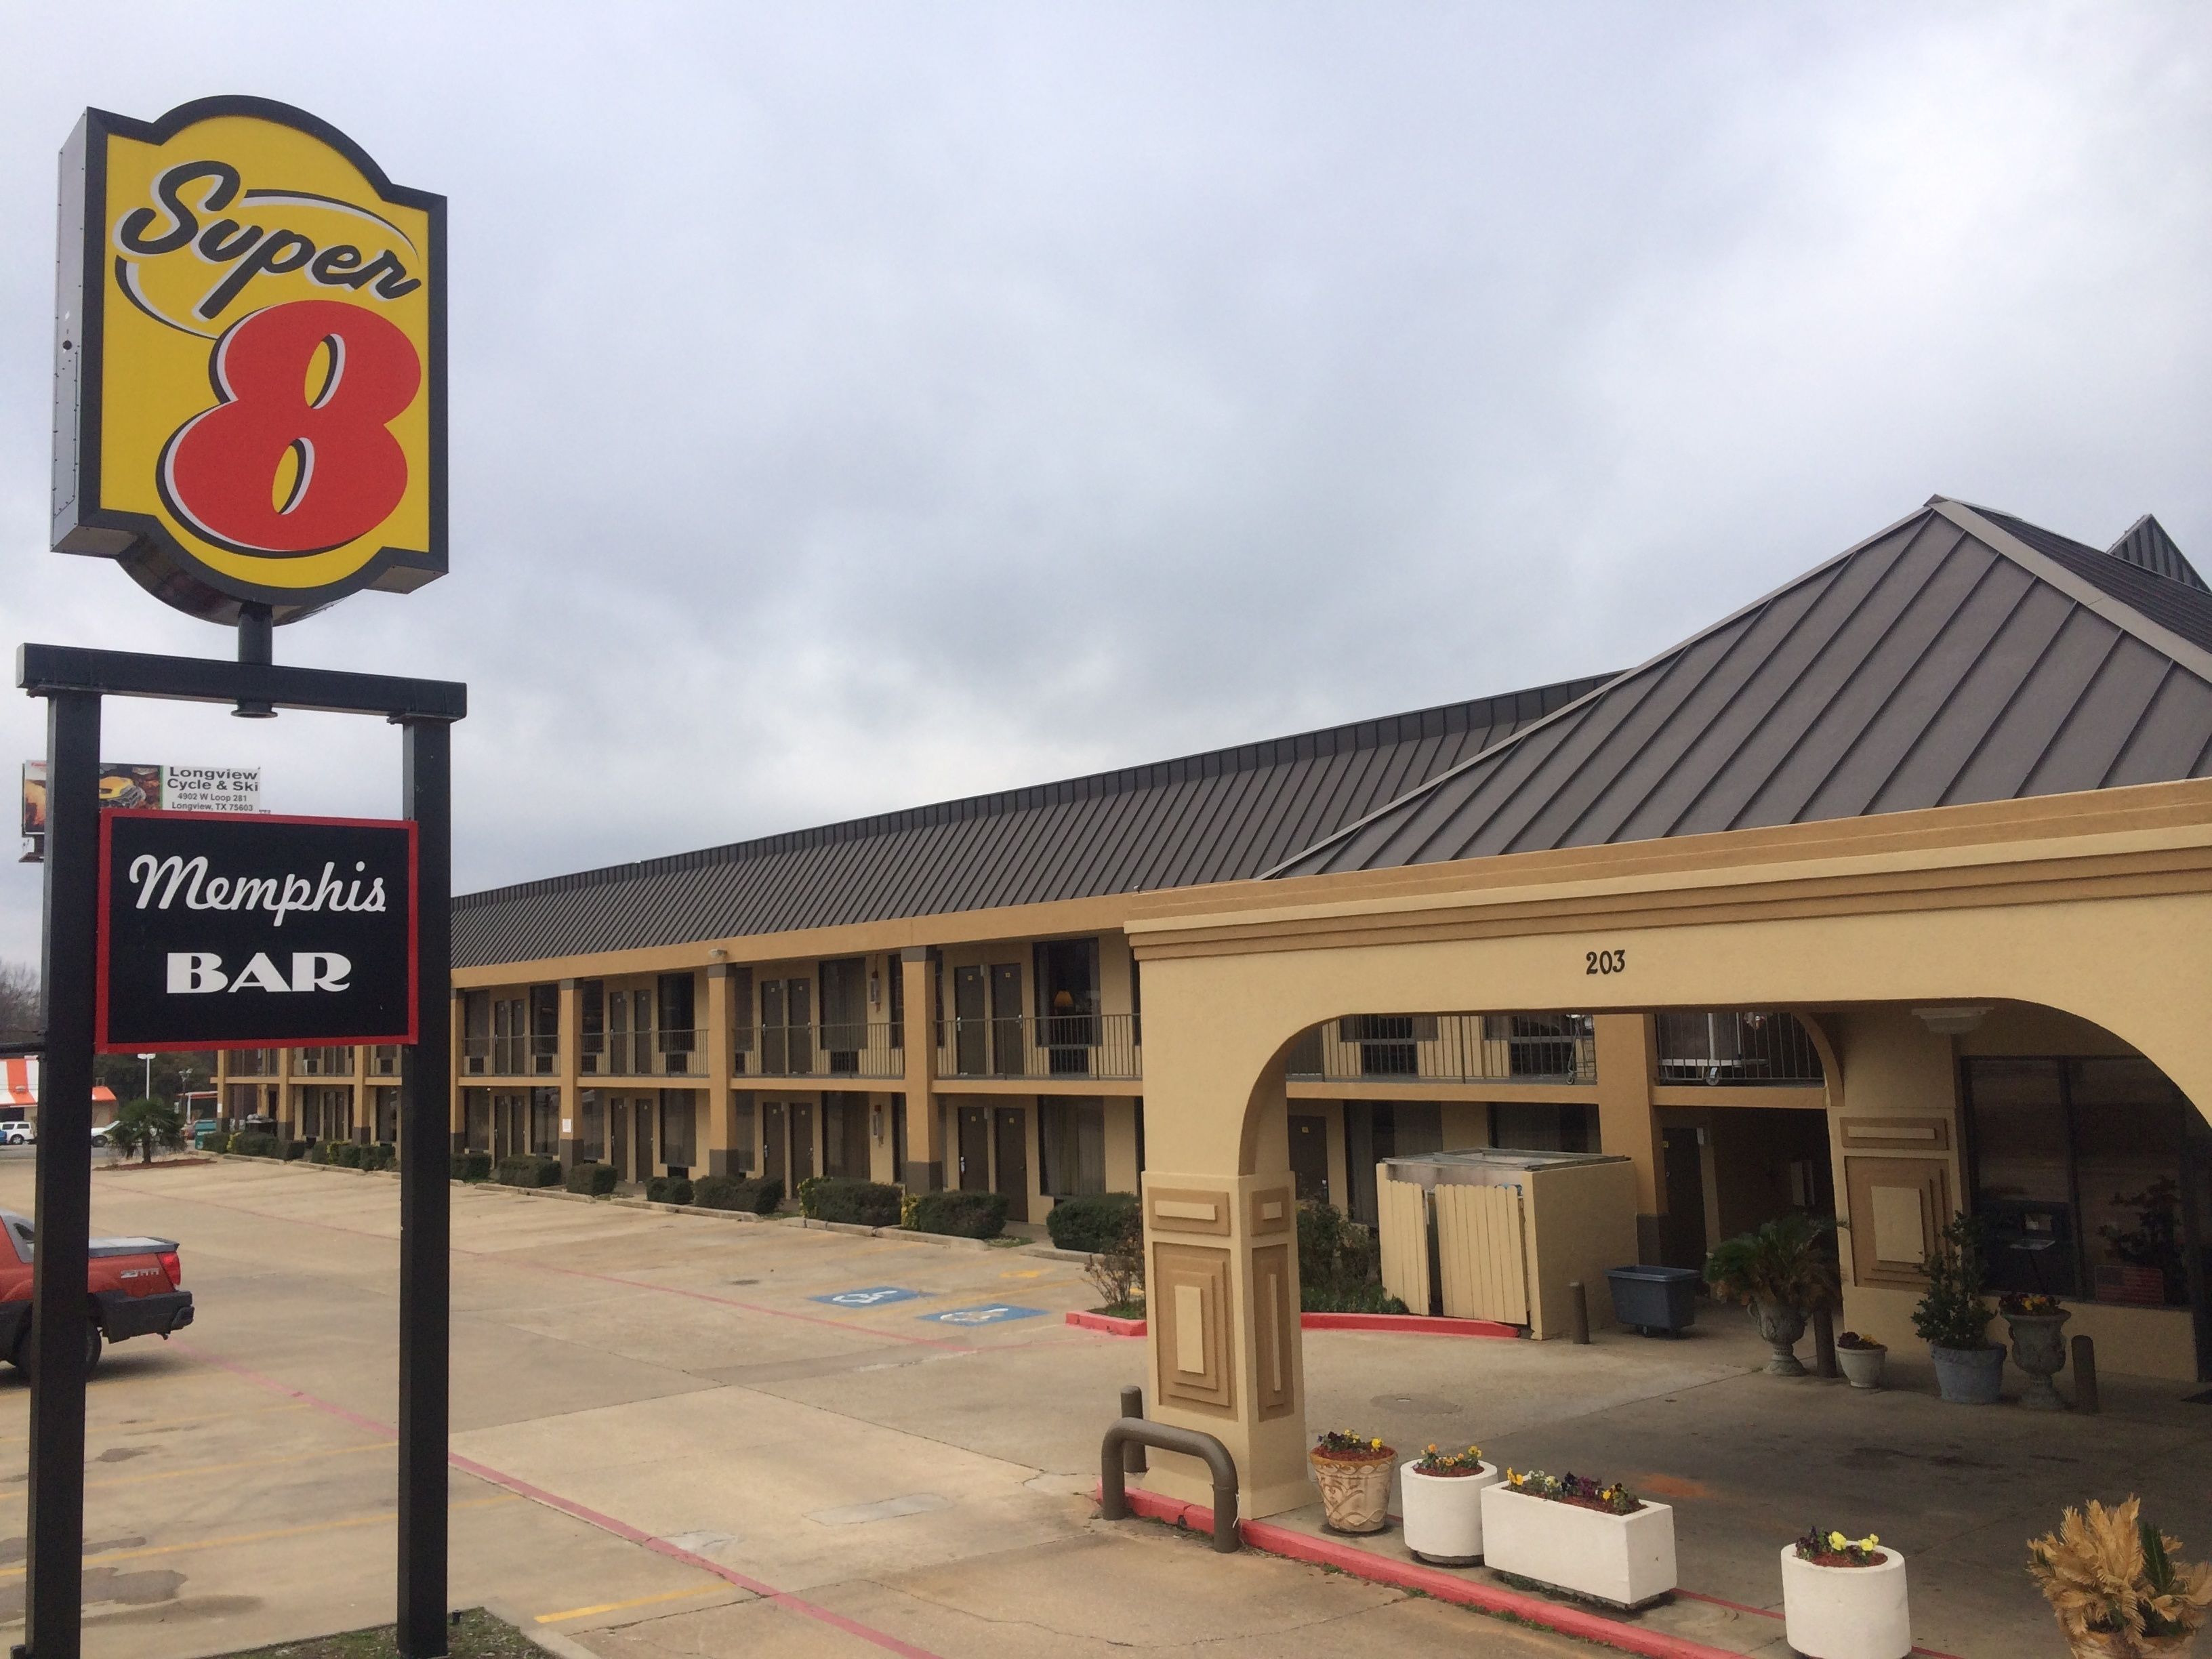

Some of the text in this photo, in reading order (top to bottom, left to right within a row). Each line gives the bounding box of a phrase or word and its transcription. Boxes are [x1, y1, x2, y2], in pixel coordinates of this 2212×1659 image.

[113, 160, 422, 322] Super
[155, 300, 422, 559] 8
[167, 779, 258, 792] Cycle & Ski
[169, 766, 258, 780] Longview
[172, 802, 213, 811] Longview,
[178, 792, 197, 800] 4902
[210, 794, 231, 802] Loop
[129, 854, 387, 926] Memphis
[166, 951, 352, 994] BAR
[1586, 949, 1626, 975] 203
